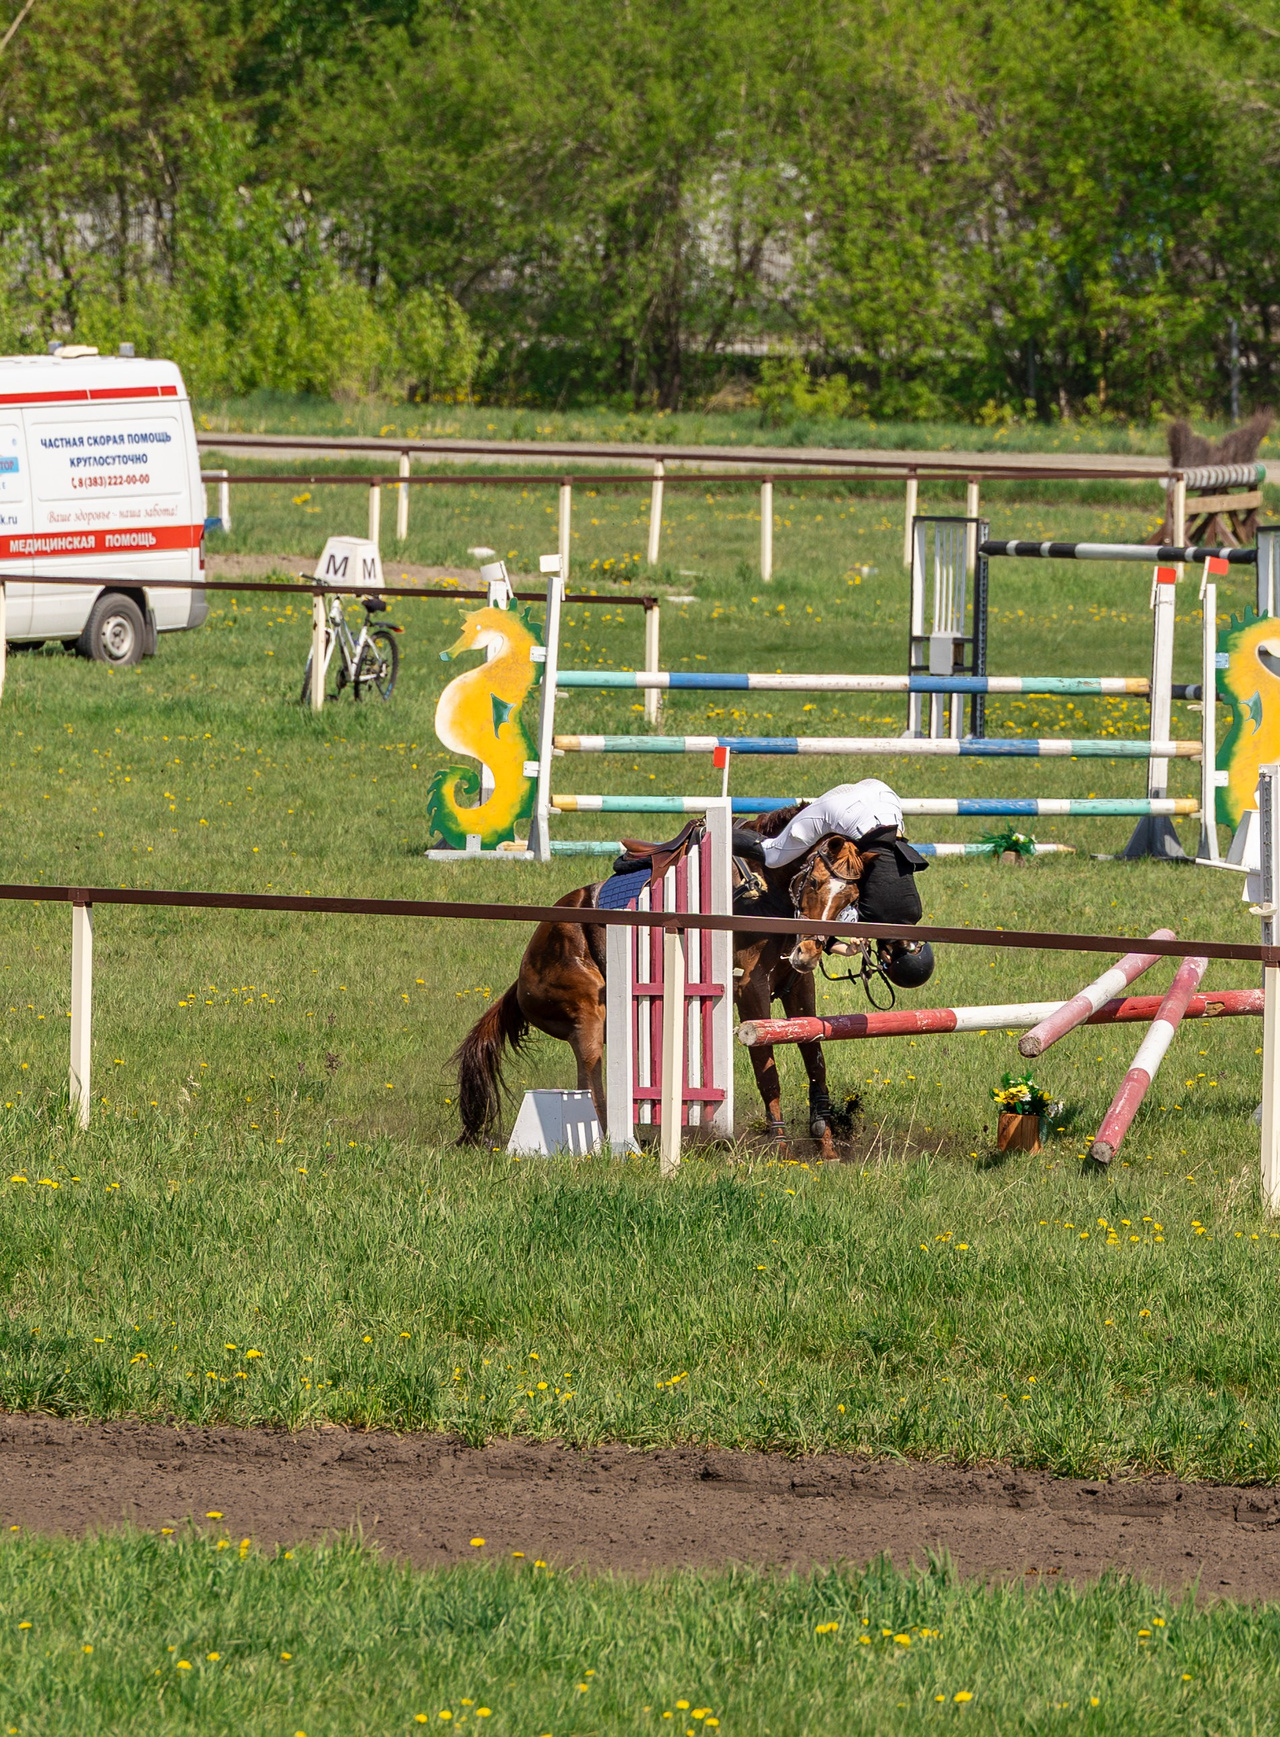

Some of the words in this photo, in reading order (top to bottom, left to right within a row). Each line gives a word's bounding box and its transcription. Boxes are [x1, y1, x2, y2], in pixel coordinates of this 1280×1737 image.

[41, 437, 85, 449] ЧАСТНАЯ
[87, 434, 125, 446] СКОРАЯ
[127, 432, 172, 444] ПОМОЩЬ
[69, 453, 148, 468] КРУГЛОСУТОЧНО
[48, 510, 71, 523] Ваше
[74, 507, 110, 525] здоровье
[119, 509, 141, 518] наша
[144, 503, 178, 517] забота!
[9, 535, 96, 554] МЕДИЦИНСКАЯ
[105, 532, 156, 548] ПОМОЩЬ
[325, 554, 349, 577] M
[362, 558, 377, 580] M
